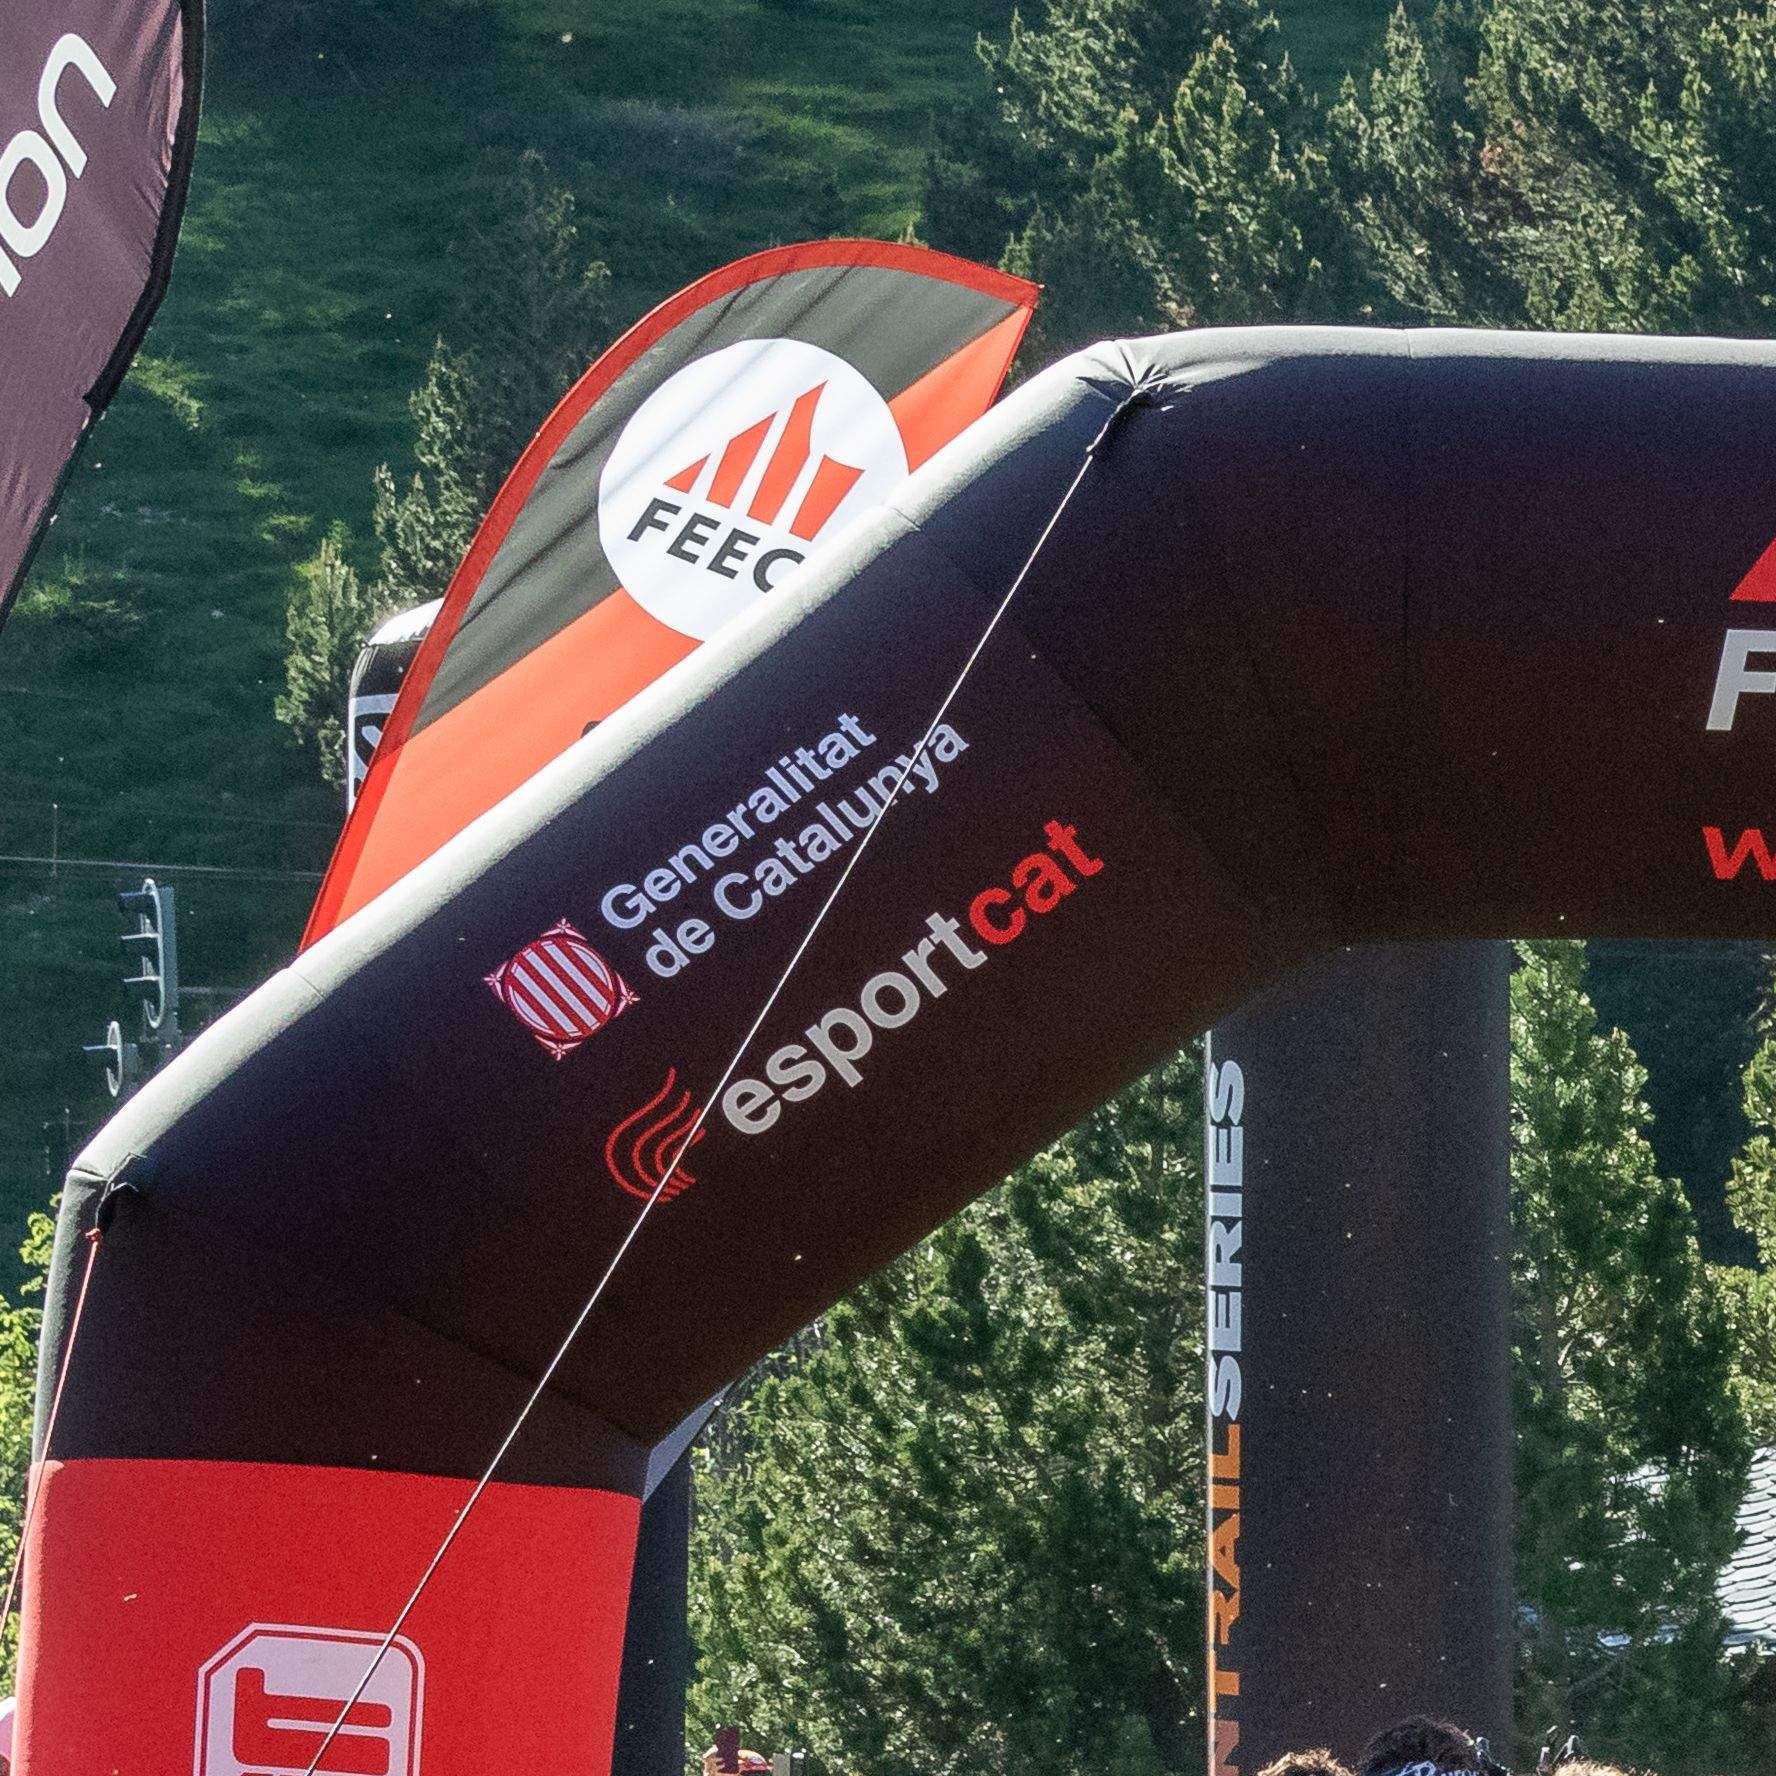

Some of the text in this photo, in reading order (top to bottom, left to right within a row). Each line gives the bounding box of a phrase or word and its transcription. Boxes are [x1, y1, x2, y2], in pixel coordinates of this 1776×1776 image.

[625, 496, 804, 594] FEEC
[600, 711, 878, 930] Generalitat
[644, 723, 970, 980] de Catalunya
